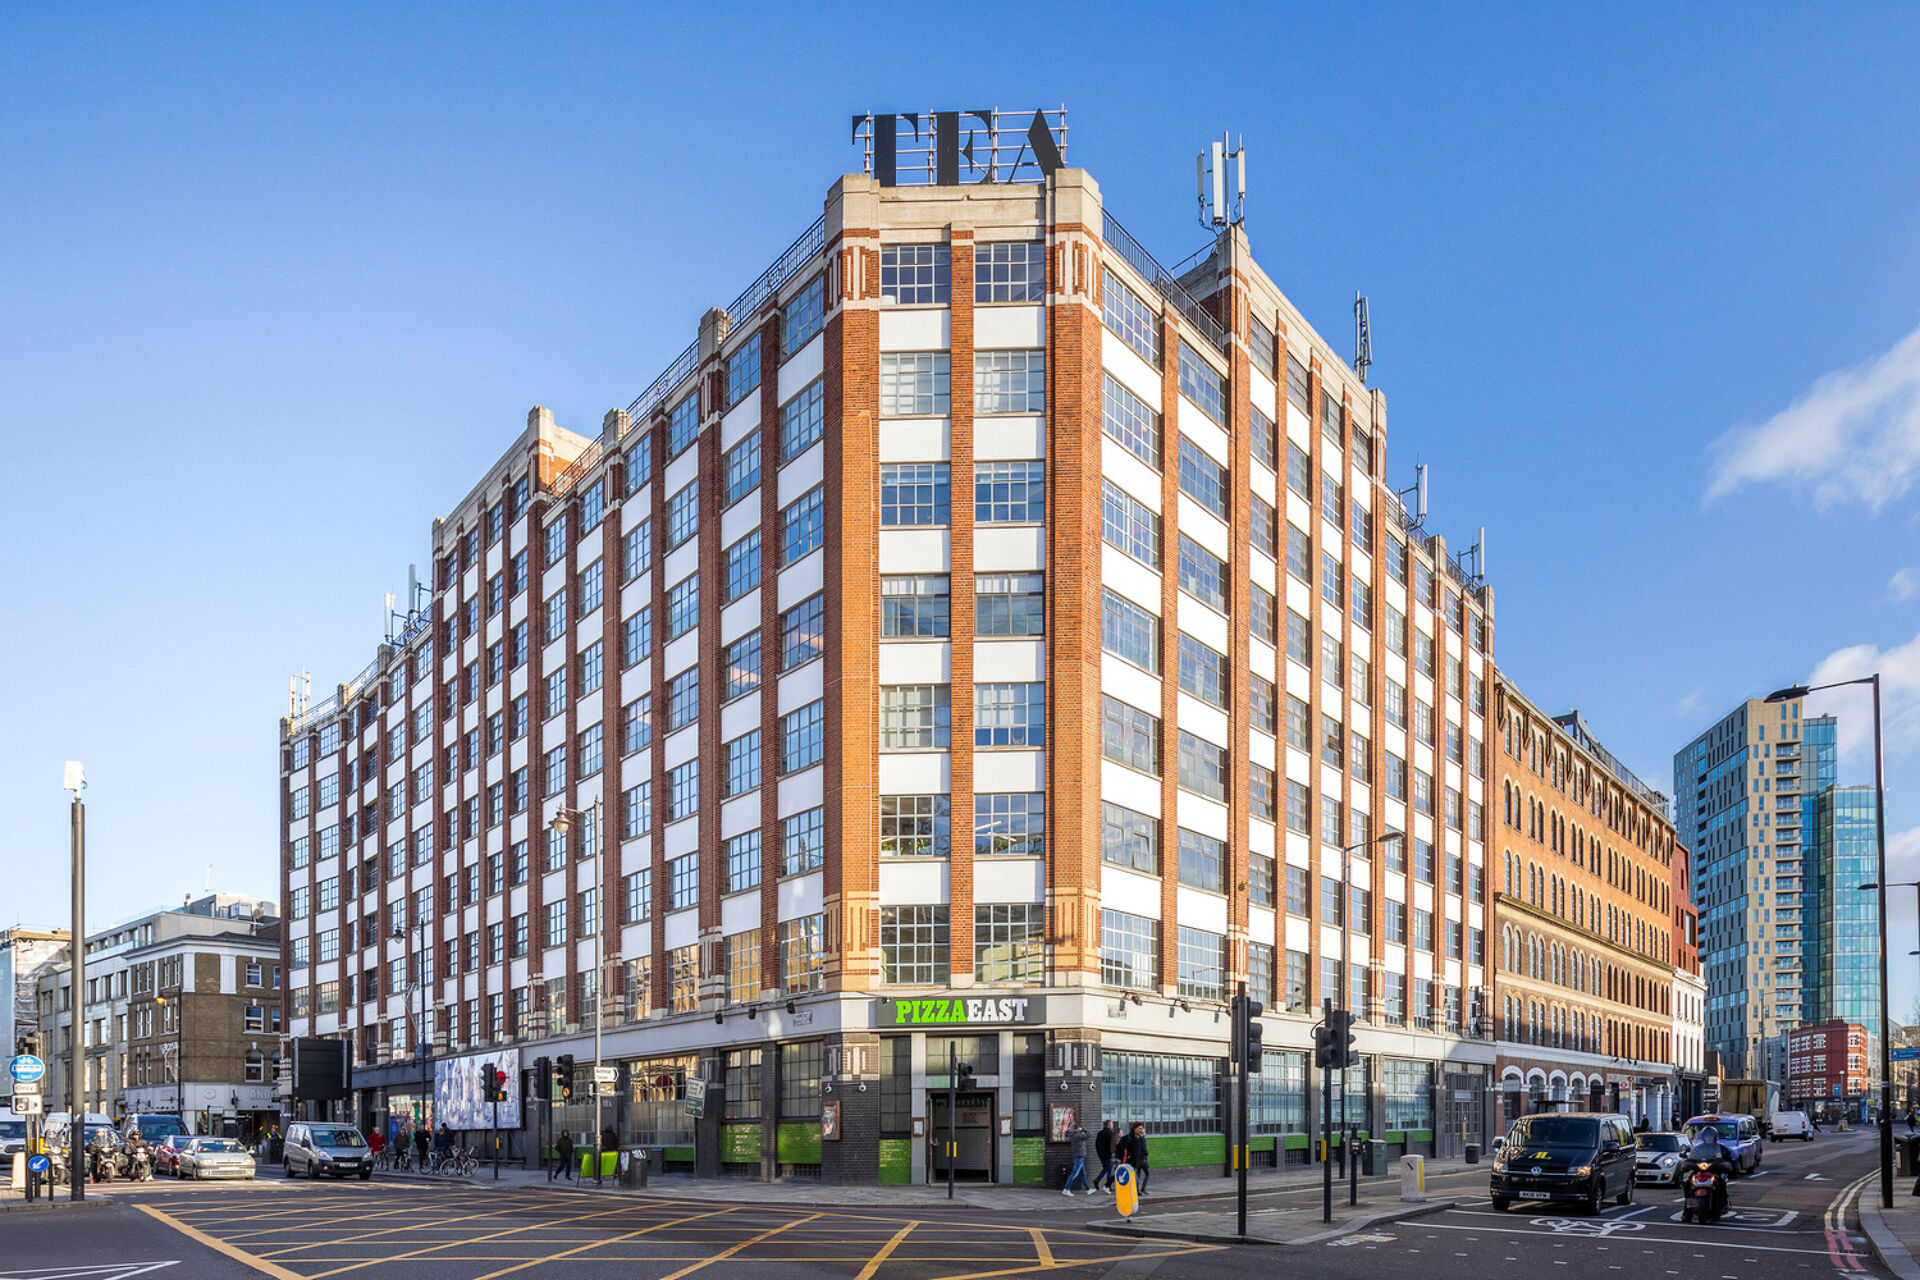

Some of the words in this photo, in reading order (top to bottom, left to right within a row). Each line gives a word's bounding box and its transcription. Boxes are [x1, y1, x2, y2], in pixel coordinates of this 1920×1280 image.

[852, 108, 1064, 187] TEA
[895, 1000, 967, 1023] PIZZA
[967, 998, 1028, 1022] EAST
